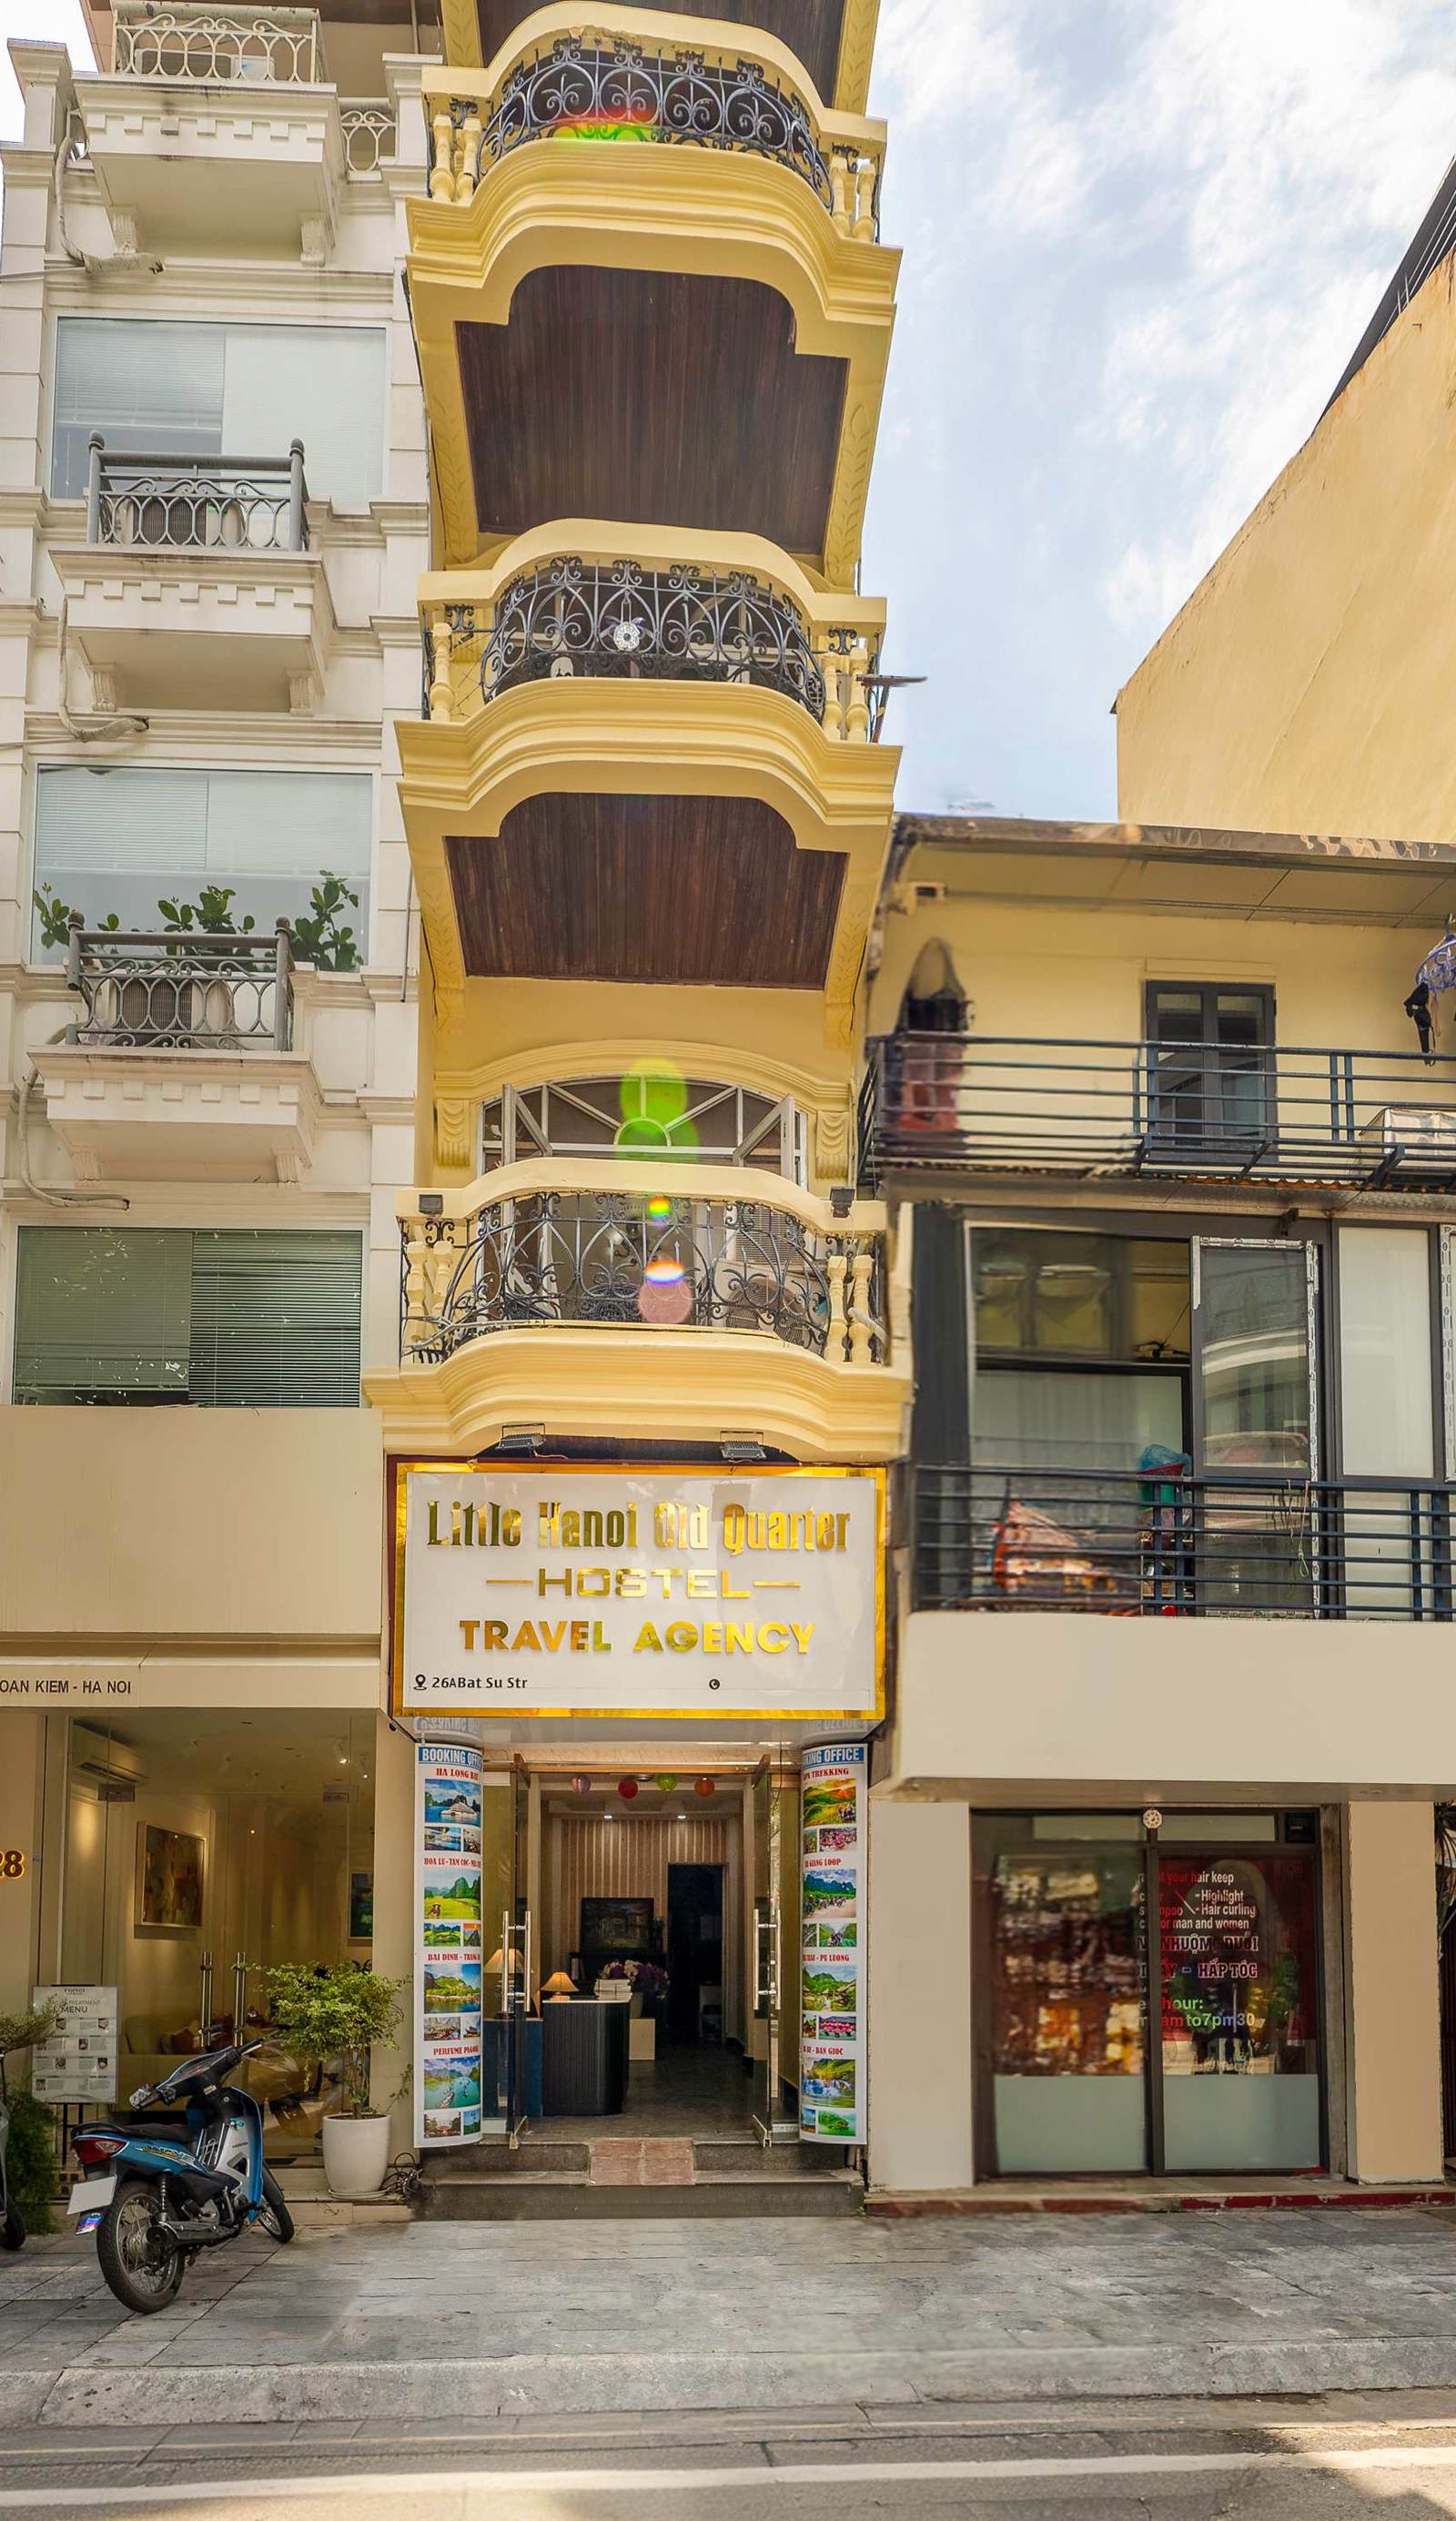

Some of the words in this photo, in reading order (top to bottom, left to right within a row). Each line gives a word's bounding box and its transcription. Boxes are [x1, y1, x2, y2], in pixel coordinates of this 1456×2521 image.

[427, 1501, 522, 1547] Little
[538, 1502, 637, 1548] Hanoi
[654, 1502, 712, 1549] Old
[723, 1503, 851, 1556] Quarter
[538, 1567, 752, 1599] HOSTEL
[459, 1620, 612, 1652] TRAVEL
[632, 1620, 816, 1654] AGENCY
[35, 1680, 69, 1693] KIEM
[83, 1680, 102, 1694] HA
[106, 1680, 131, 1694] NOI
[485, 1676, 503, 1689] Su
[506, 1676, 528, 1689] Str
[422, 1748, 466, 1764] BOOKING
[467, 1752, 481, 1767] OFF
[824, 1748, 859, 1763] OFFICE
[450, 1768, 469, 1778] LONG
[812, 1767, 849, 1778] TREKKING
[824, 1858, 842, 1867] LOOP
[1191, 1871, 1208, 1883] hair
[1211, 1870, 1234, 1886] keep
[1201, 1889, 1245, 1905] Highlight
[1201, 1903, 1220, 1916] Hair
[1222, 1903, 1256, 1918] curling
[1173, 1919, 1193, 1929] man
[1195, 1917, 1213, 1929] and
[1215, 1919, 1249, 1929] women
[1197, 1958, 1228, 1979] HẤP
[62, 2005, 88, 2014] MENU
[1161, 1997, 1203, 2010] hour:
[433, 2046, 462, 2056] PERFUME
